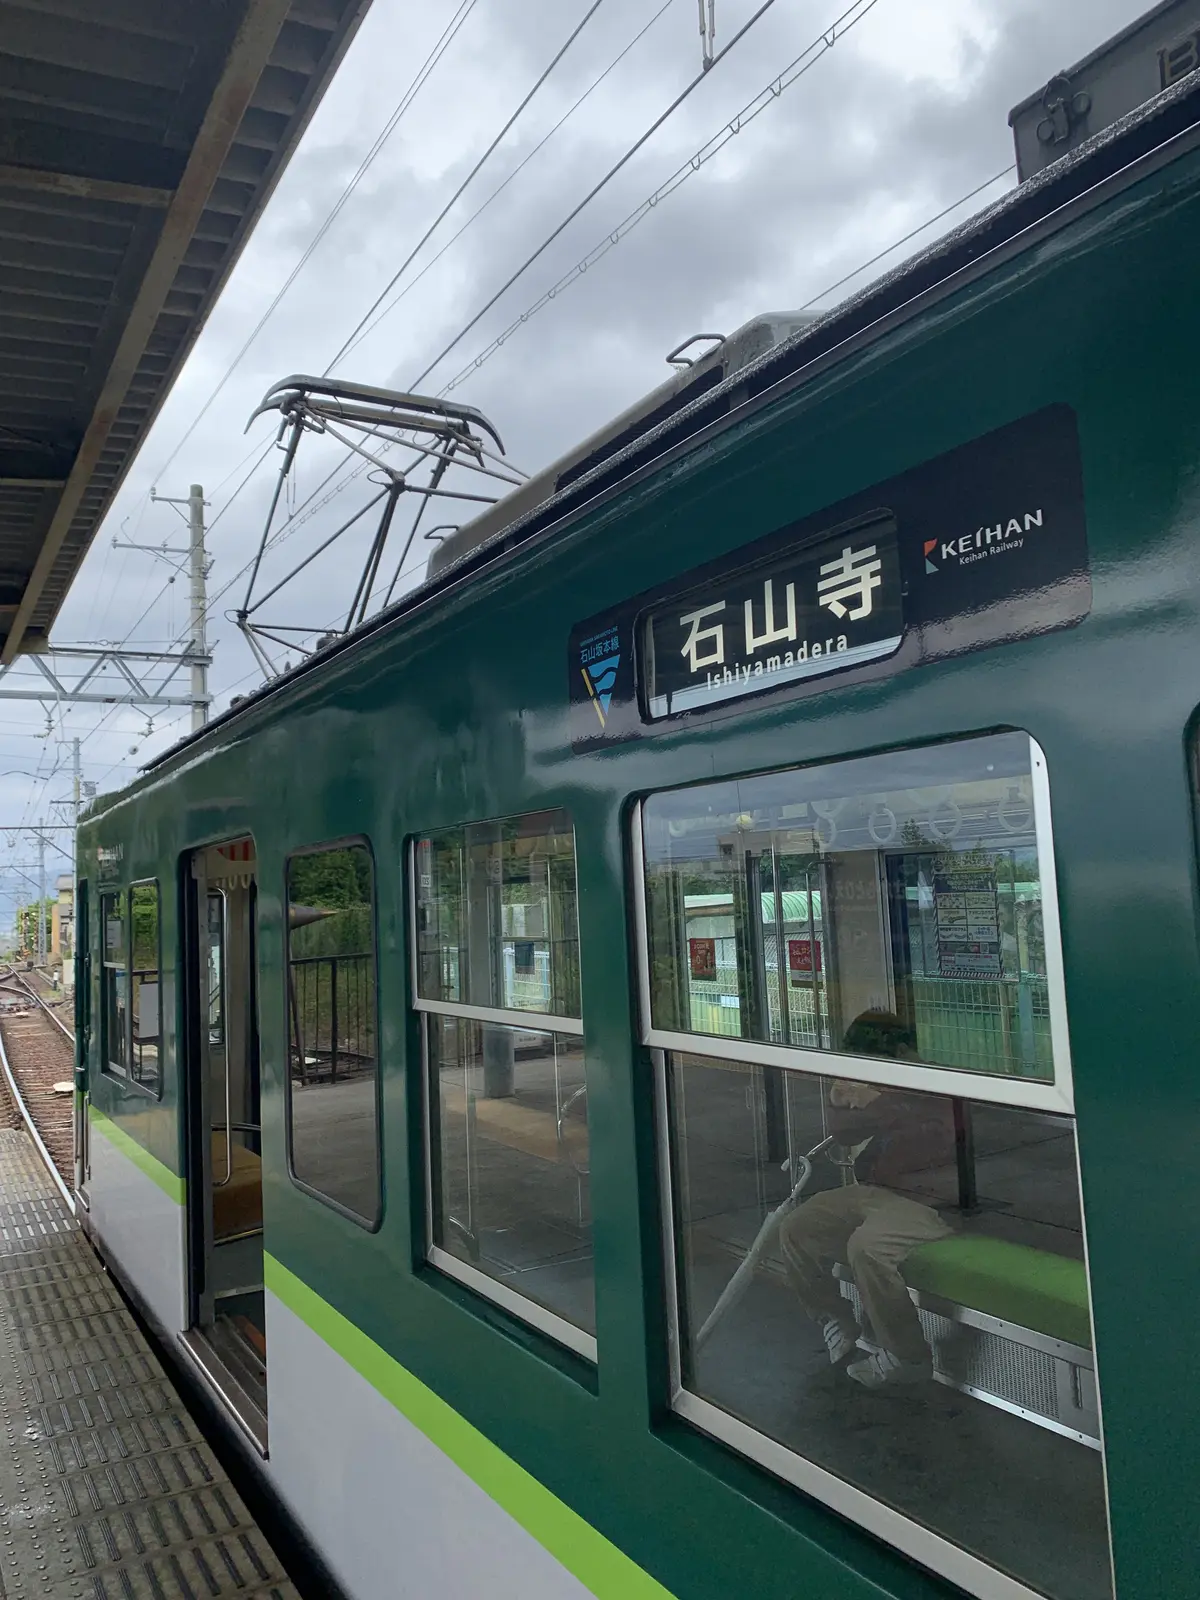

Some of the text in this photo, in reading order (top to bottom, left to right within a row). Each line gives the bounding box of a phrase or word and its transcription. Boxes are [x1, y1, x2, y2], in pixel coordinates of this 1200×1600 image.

[941, 509, 1043, 559] KEIHAN
[959, 538, 1024, 565] Keihan Railway
[680, 545, 882, 673] 石山寺
[707, 634, 848, 691] Ishiyamadera
